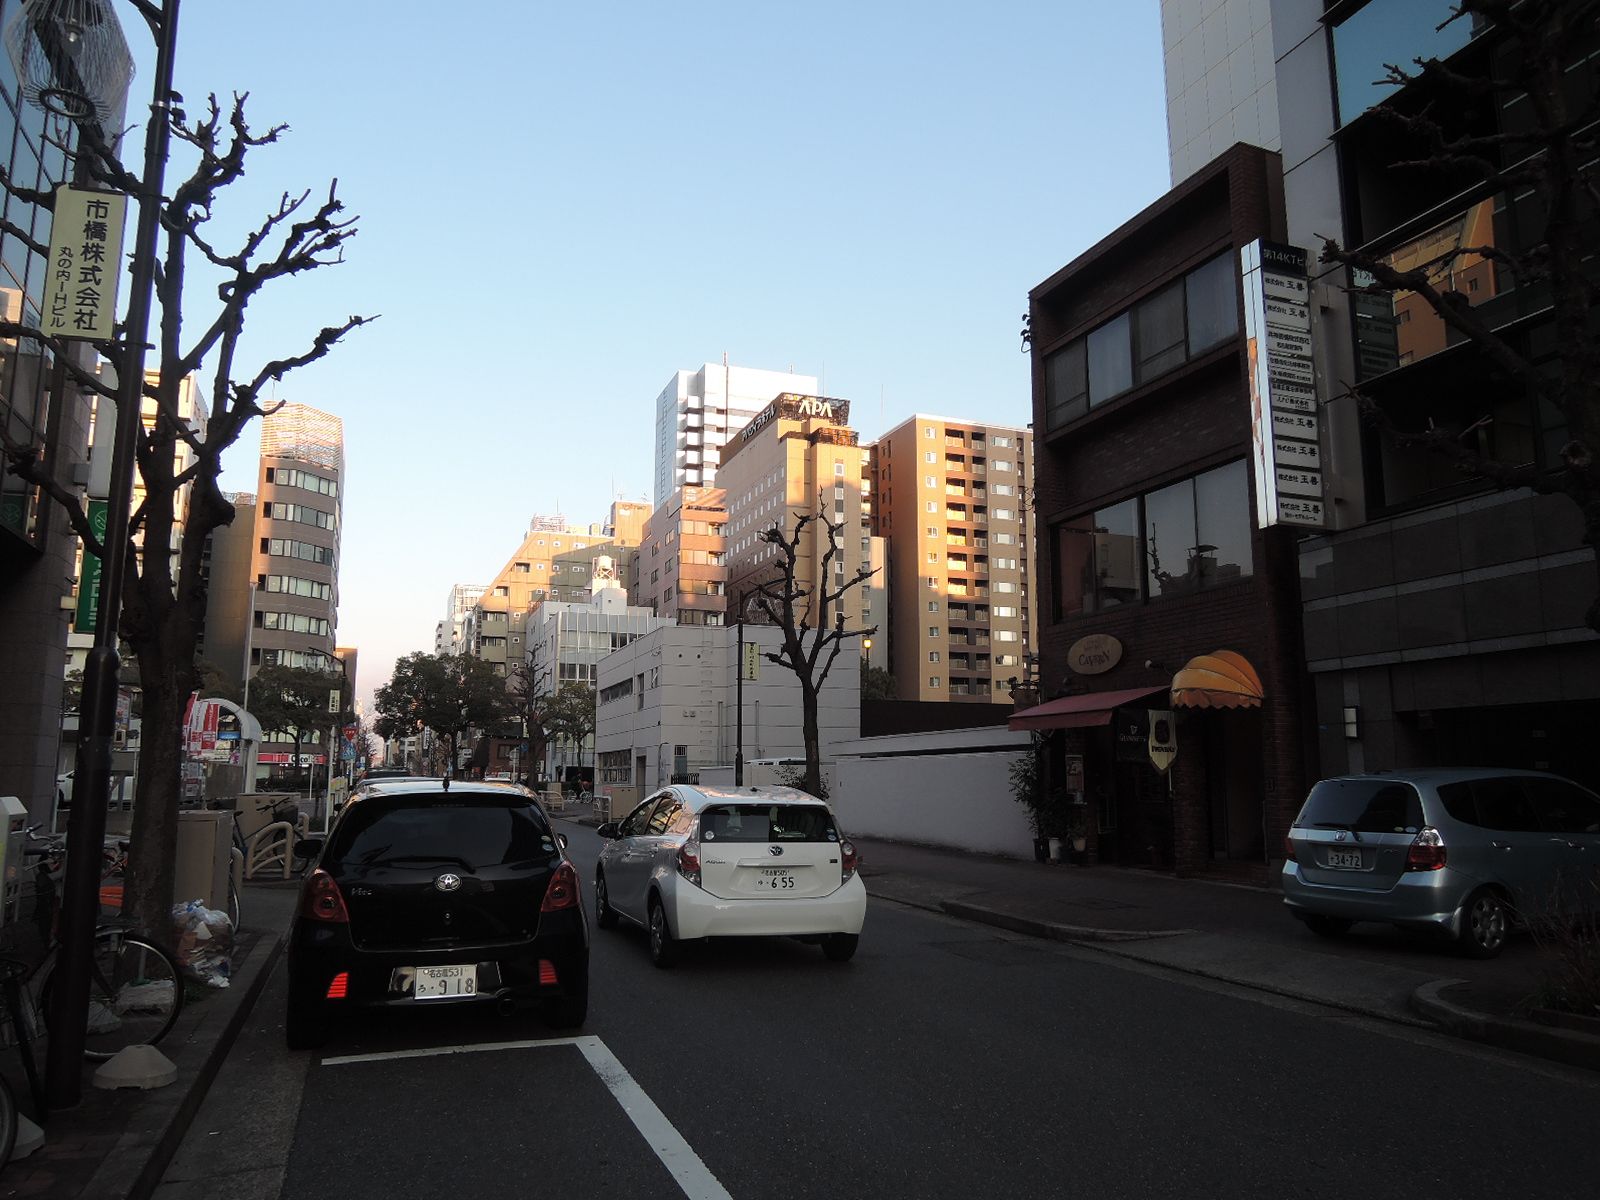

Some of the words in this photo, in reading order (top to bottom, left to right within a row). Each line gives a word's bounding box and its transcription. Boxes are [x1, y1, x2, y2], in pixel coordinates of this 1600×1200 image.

[73, 199, 110, 331] 市橋株式会社
[798, 399, 833, 418] APA
